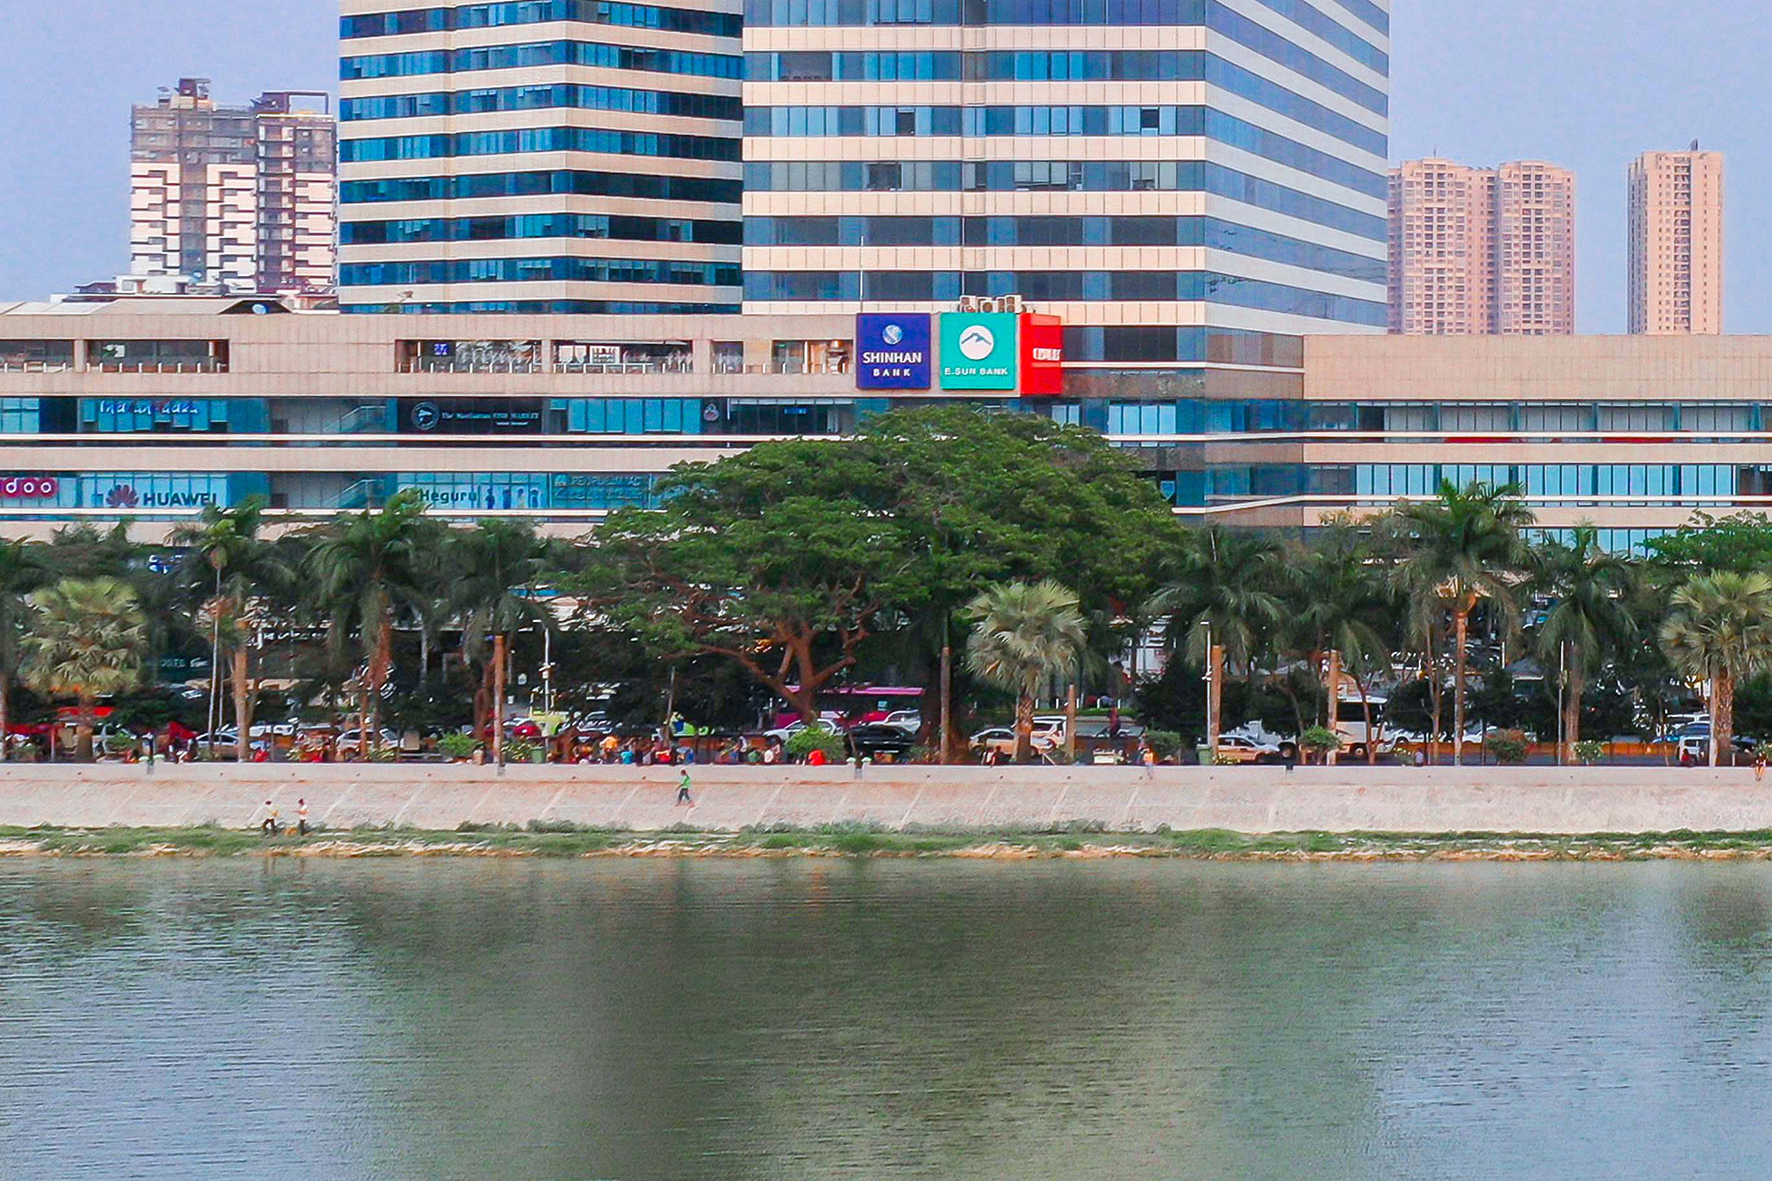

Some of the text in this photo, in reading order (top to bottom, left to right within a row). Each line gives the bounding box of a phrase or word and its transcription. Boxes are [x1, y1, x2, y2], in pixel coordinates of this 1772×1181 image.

[862, 351, 922, 364] SHINHAN
[873, 368, 911, 377] BANK
[944, 367, 1008, 376] E.SUN BANK
[143, 492, 217, 507] HUAWEI
[420, 489, 477, 504] Heguru
